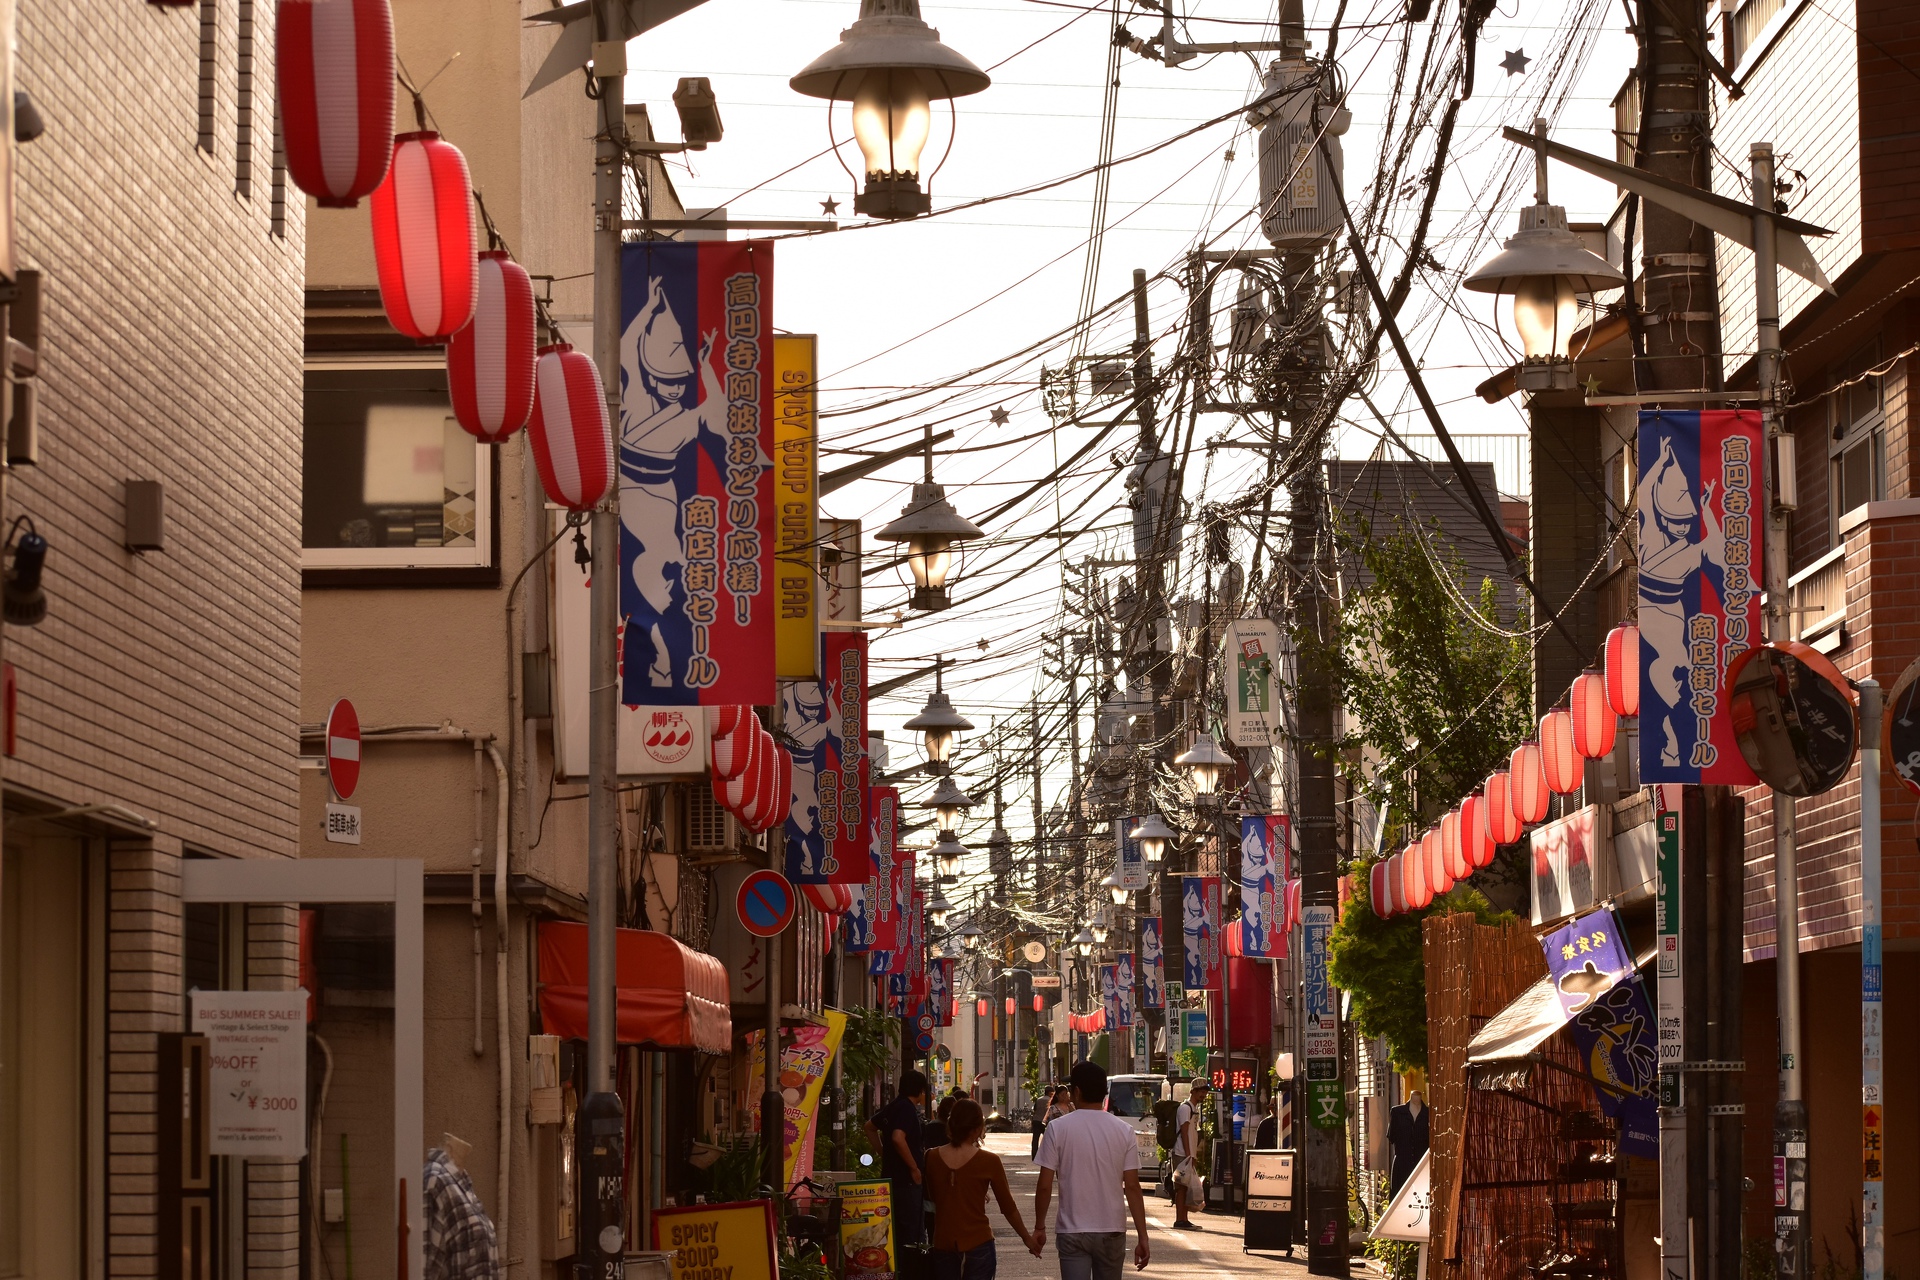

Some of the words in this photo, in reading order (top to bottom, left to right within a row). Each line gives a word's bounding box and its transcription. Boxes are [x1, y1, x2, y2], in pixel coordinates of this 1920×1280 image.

[1293, 186, 1316, 198] 125
[782, 370, 808, 430] SPICY
[725, 273, 759, 625] 高円寺阿波おどり応援！
[782, 439, 808, 494] SOUP
[782, 502, 809, 567] CURRY
[1723, 436, 1751, 690] 高円寺阿波おどり応
[684, 497, 719, 688] 商店街セール
[781, 577, 810, 619] BAR
[1245, 640, 1261, 658] 質
[1245, 666, 1261, 711] 大丸屋
[1689, 614, 1718, 768] 商店街セール
[652, 712, 684, 728] 柳亭
[652, 748, 686, 762] YANAGITEI
[841, 649, 861, 841] 高円寺阿波おどり応援！
[818, 770, 838, 875] 商店街セール
[1665, 818, 1675, 830] 取
[1311, 927, 1326, 1008] 東急リバブル
[199, 1009, 217, 1020] BIG
[220, 1009, 266, 1020] SUMMER
[211, 1023, 237, 1032] Vintage
[246, 1023, 269, 1031] Select
[270, 1023, 289, 1032] Shop
[921, 1019, 931, 1027] 20
[1169, 1000, 1180, 1035] 清川病院
[216, 1035, 249, 1043] VINTAGE
[250, 1035, 278, 1043] clothes
[1307, 1048, 1336, 1056] 965-080
[1316, 1085, 1339, 1093] 通学路
[262, 1097, 298, 1111] 3000
[1317, 1094, 1339, 1120] 文
[1864, 1131, 1882, 1179] 注意
[841, 1188, 854, 1196] The
[855, 1187, 876, 1195] Lotus
[1251, 1200, 1268, 1209] ラビアン
[1272, 1201, 1287, 1209] ローズ
[671, 1221, 719, 1247] SPICY
[676, 1245, 719, 1269] SOUP
